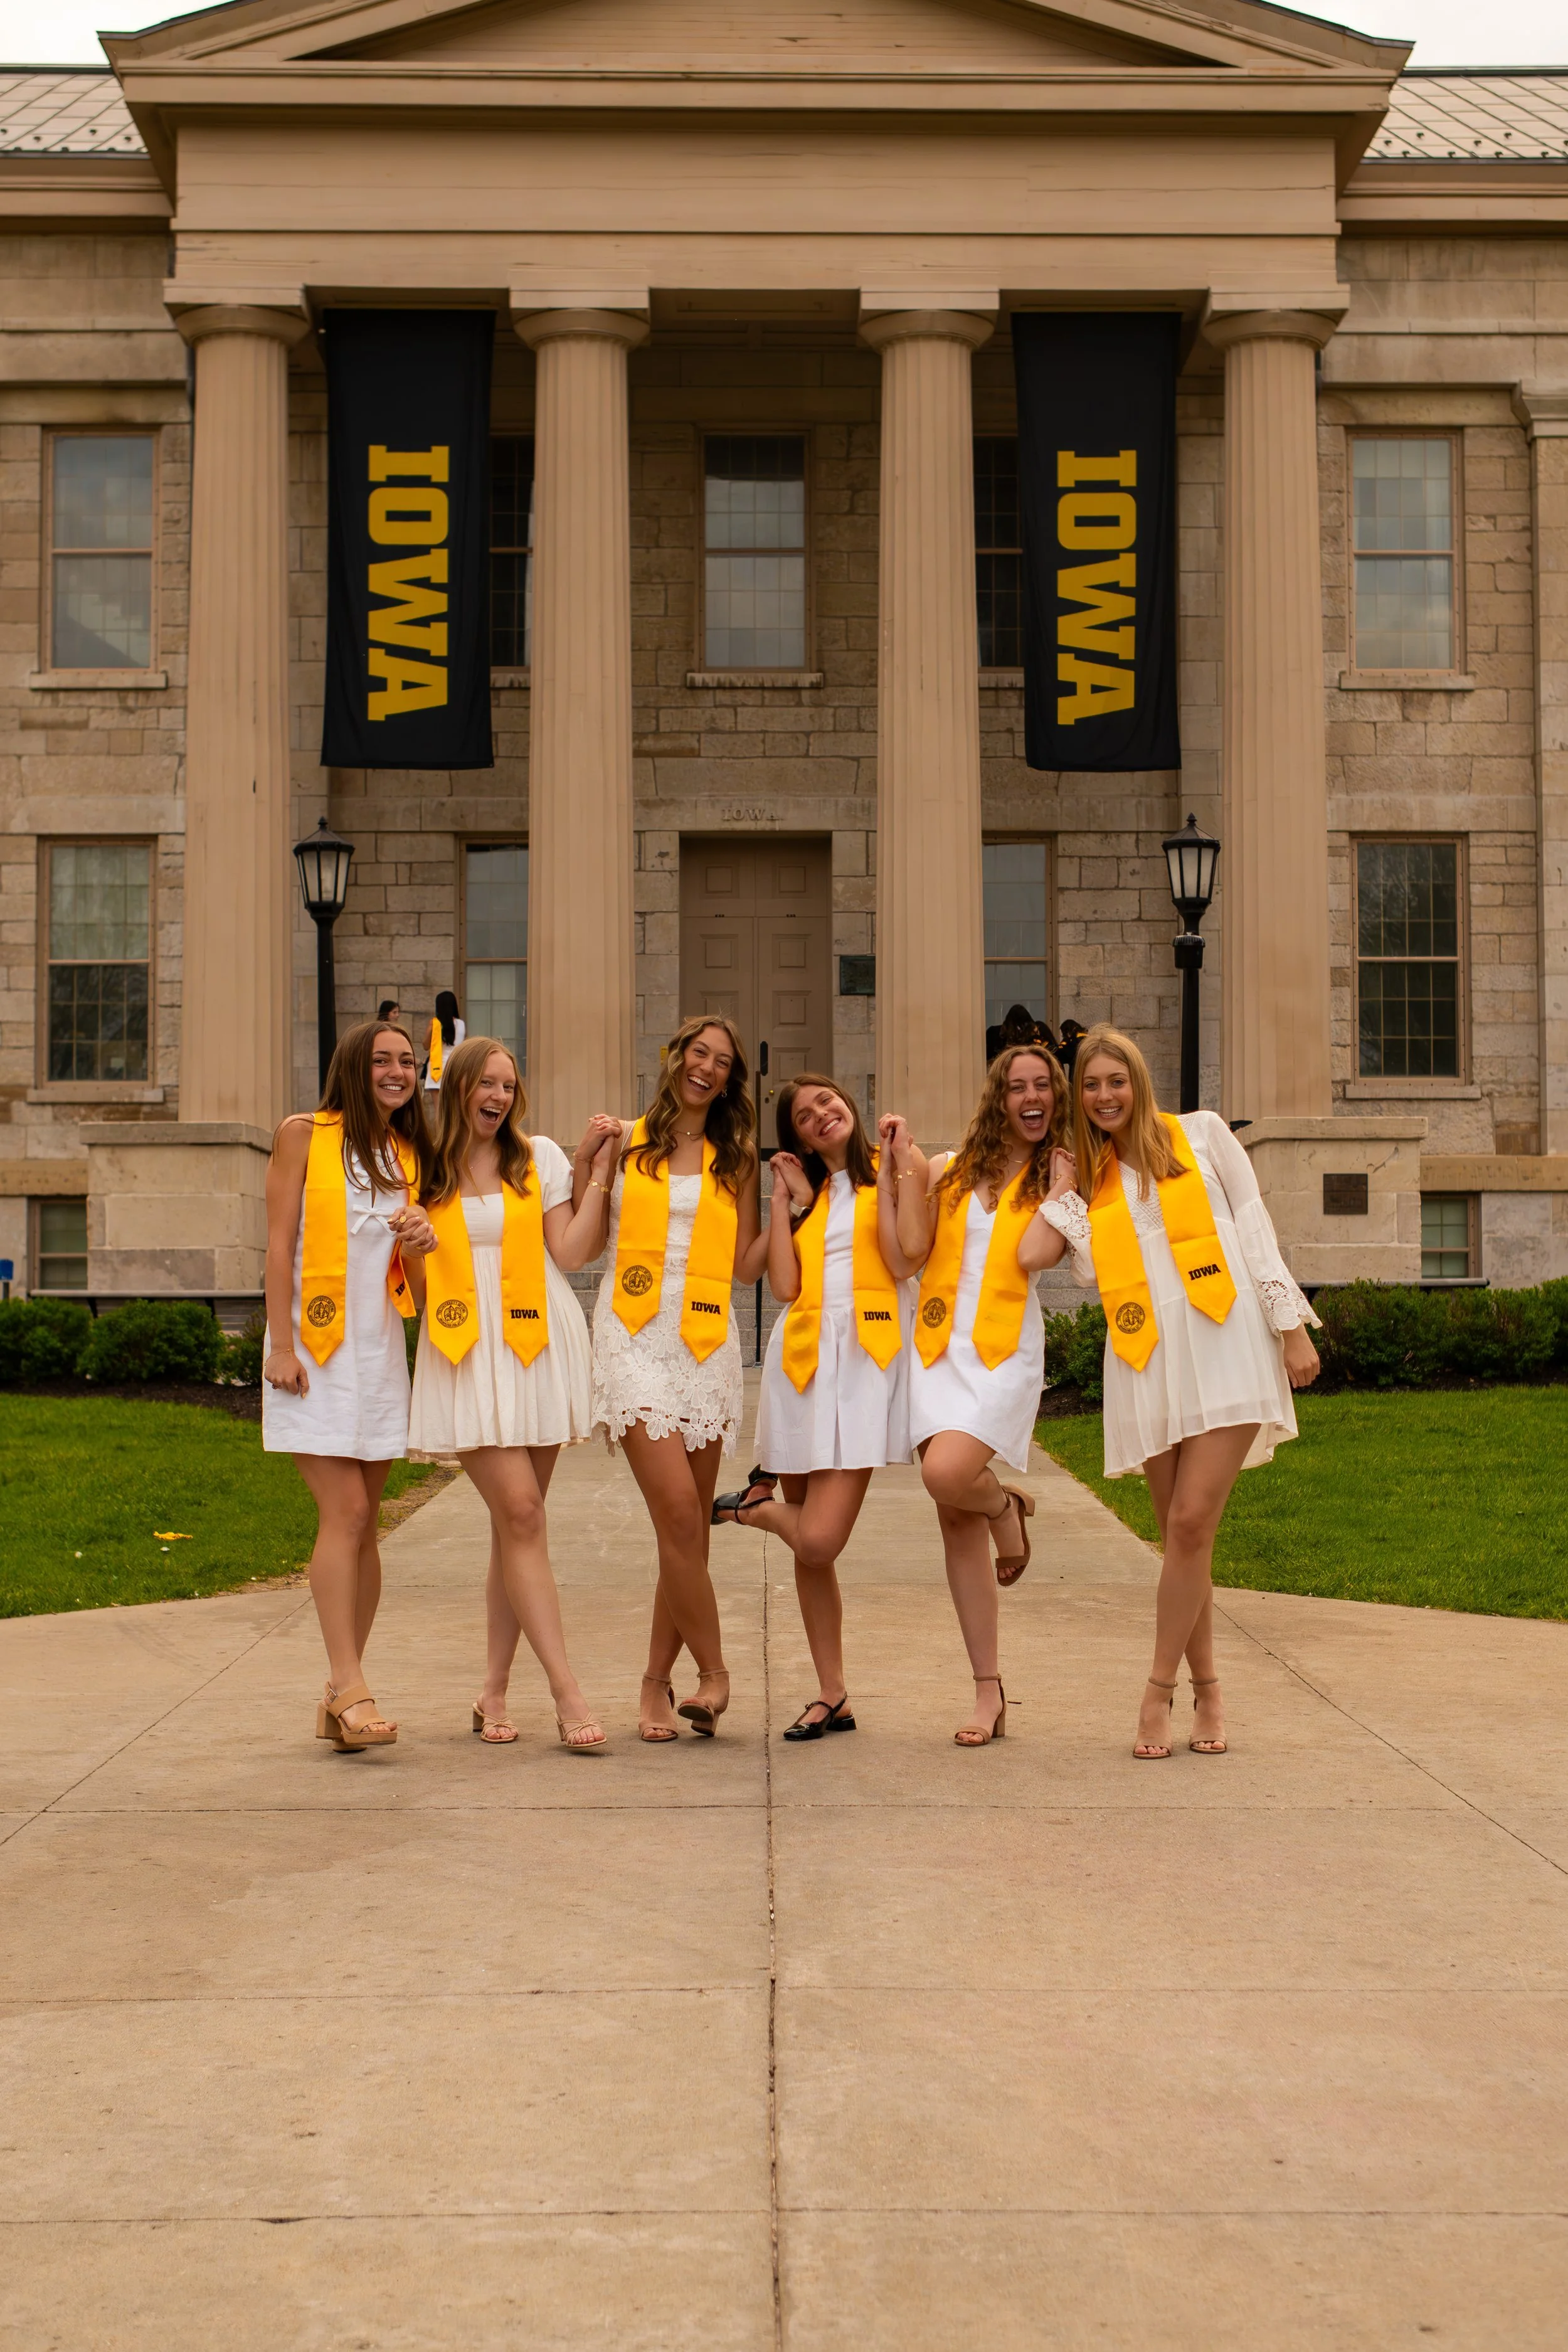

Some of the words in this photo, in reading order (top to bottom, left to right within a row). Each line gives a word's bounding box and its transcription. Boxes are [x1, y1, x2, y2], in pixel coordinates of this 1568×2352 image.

[368, 444, 449, 722] IOWA
[1056, 450, 1137, 725] IOWA
[720, 808, 784, 821] IOWA
[1189, 1264, 1221, 1281] IOWA
[510, 1309, 539, 1319] IOWA
[691, 1301, 721, 1315] IOWA
[864, 1311, 892, 1321] IOWA
